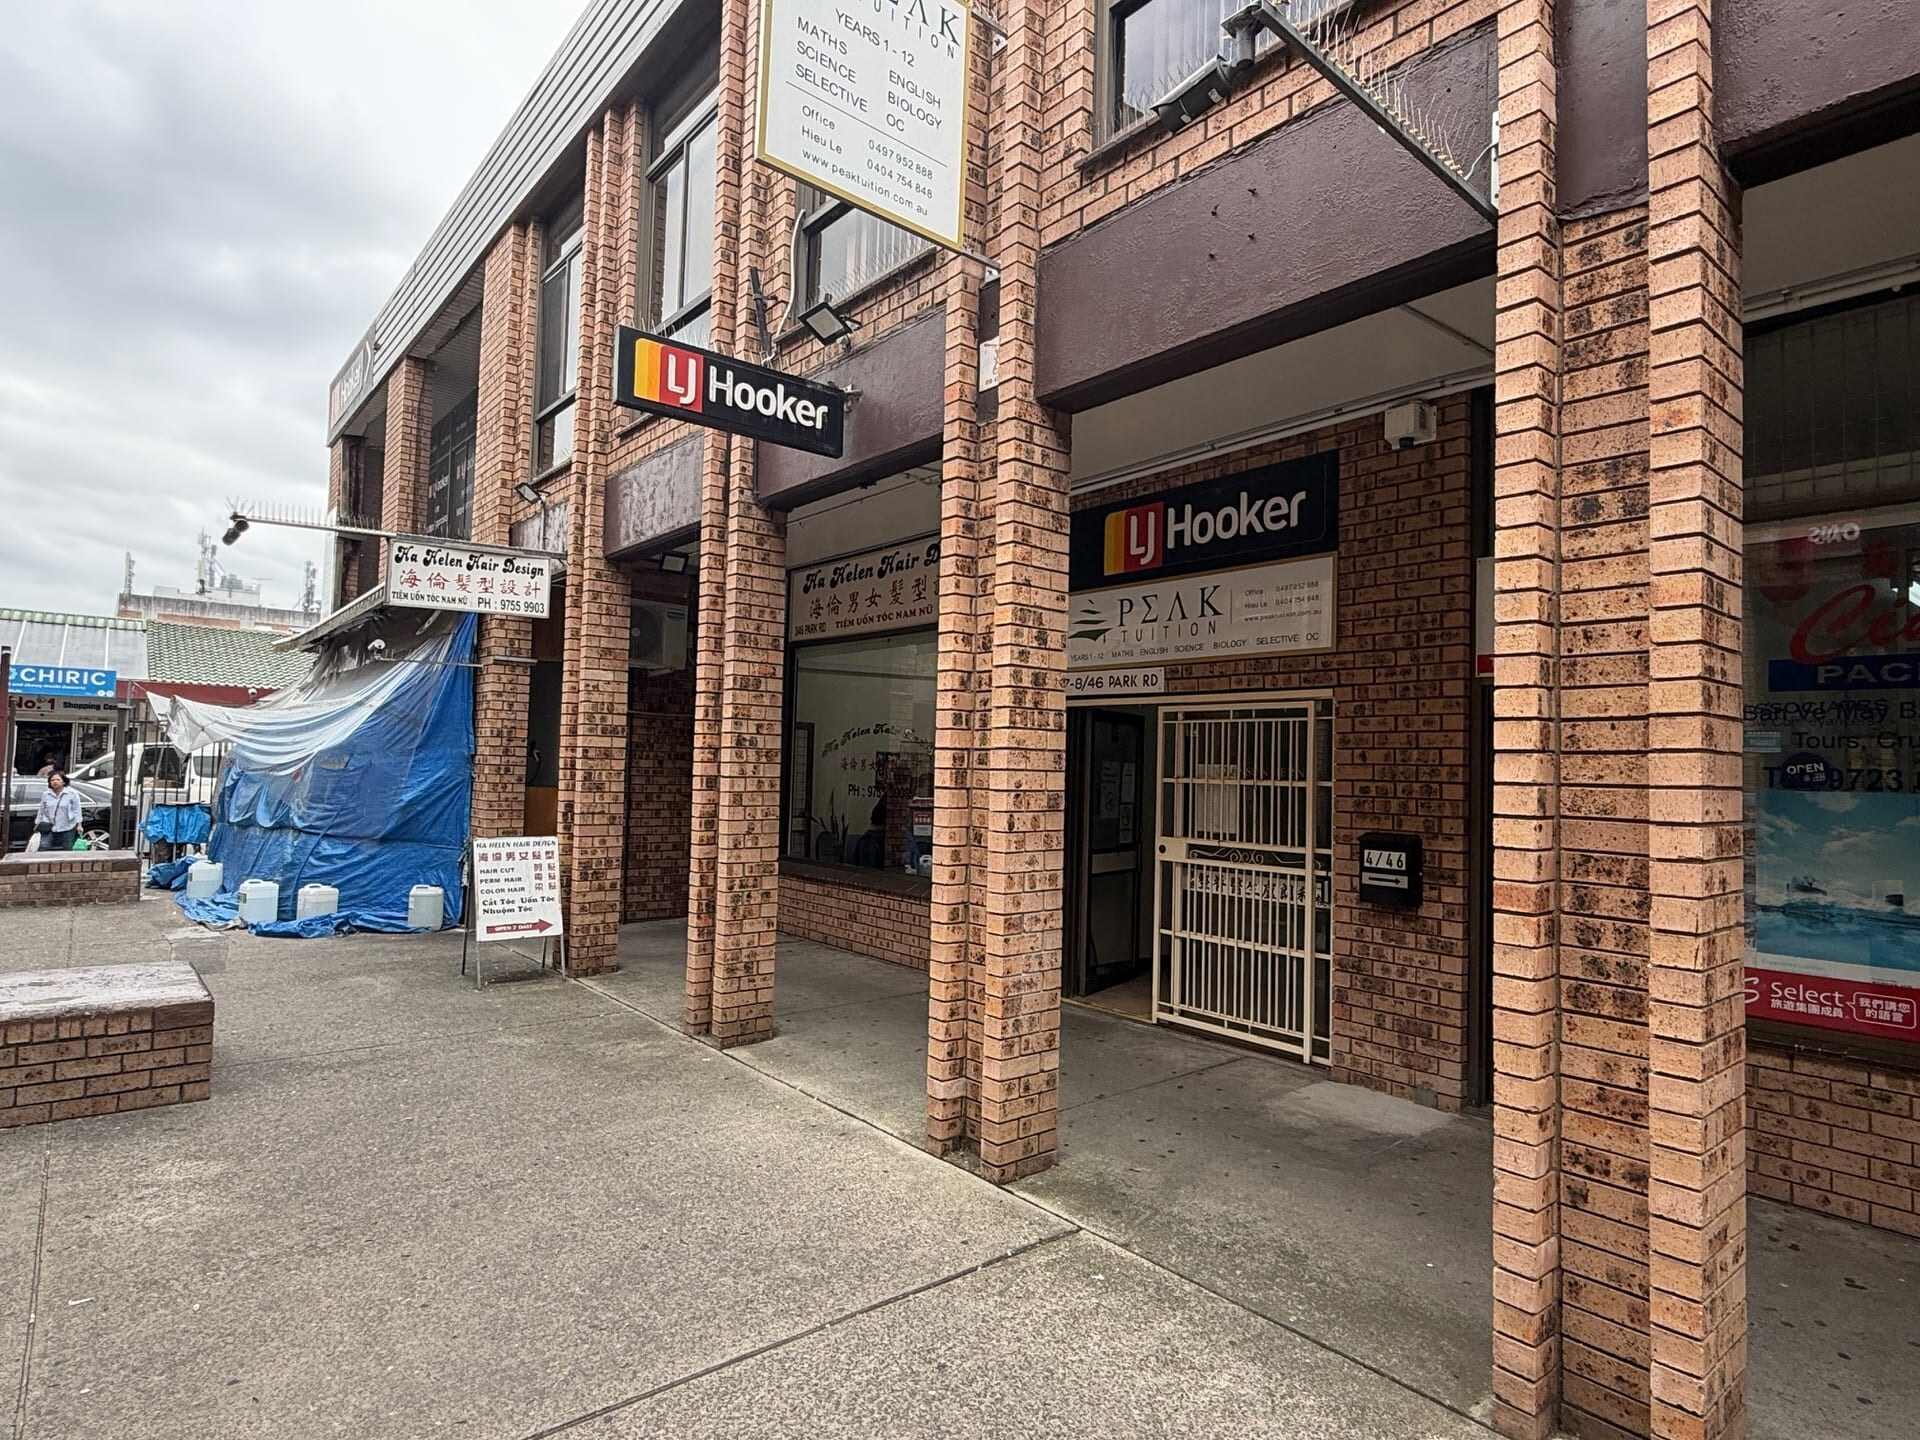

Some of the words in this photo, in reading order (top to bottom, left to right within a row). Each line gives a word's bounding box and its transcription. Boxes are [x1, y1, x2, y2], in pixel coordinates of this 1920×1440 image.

[797, 17, 848, 55] MATHS
[835, 8, 881, 46] YEARS
[883, 39, 889, 52] 1
[902, 50, 915, 67] 12
[874, 0, 955, 59] UITION
[796, 40, 857, 84] SCIENCE
[795, 63, 868, 113] SELECTIVE
[889, 70, 942, 109] ENGLISH
[886, 113, 905, 132] OC
[887, 91, 942, 130] BIOLOGY
[801, 105, 836, 130] Office
[868, 139, 894, 161] 0497
[895, 151, 914, 172] 952
[915, 162, 933, 181] 888
[801, 125, 827, 148] Hieu
[829, 138, 842, 154] Le
[866, 159, 893, 180] 0404
[896, 172, 913, 190] 754
[914, 181, 933, 199] 848
[667, 353, 697, 405] LJ
[709, 365, 829, 430] Hooker
[1130, 511, 1155, 565] LJ
[1167, 491, 1306, 549] Hooker
[394, 545, 418, 563] Ha
[422, 549, 463, 568] Helen
[466, 554, 499, 571] Hair
[502, 557, 544, 579] Design
[803, 569, 825, 594] Ha
[830, 562, 874, 589] Helen
[877, 550, 920, 579] Hair
[478, 597, 491, 609] PH
[500, 599, 521, 611] 9755
[524, 601, 545, 614] 9903
[809, 575, 941, 619] 海倫男女髮型
[896, 608, 917, 619] NAM
[1111, 649, 1134, 658] MATHS
[1140, 647, 1168, 656] ENGLISH
[1174, 643, 1204, 653] SCIENCE
[1213, 639, 1247, 650] BIOLOGY
[1256, 634, 1299, 646] SELECTIVE
[1305, 632, 1319, 641] OC
[1121, 620, 1216, 644] TUITION
[1109, 674, 1137, 688] PARK
[1143, 672, 1158, 687] RD
[1817, 661, 1920, 684] PAC
[63, 701, 101, 711] Shopping
[1365, 852, 1404, 869] 4/46
[1771, 981, 1844, 1007] Select
